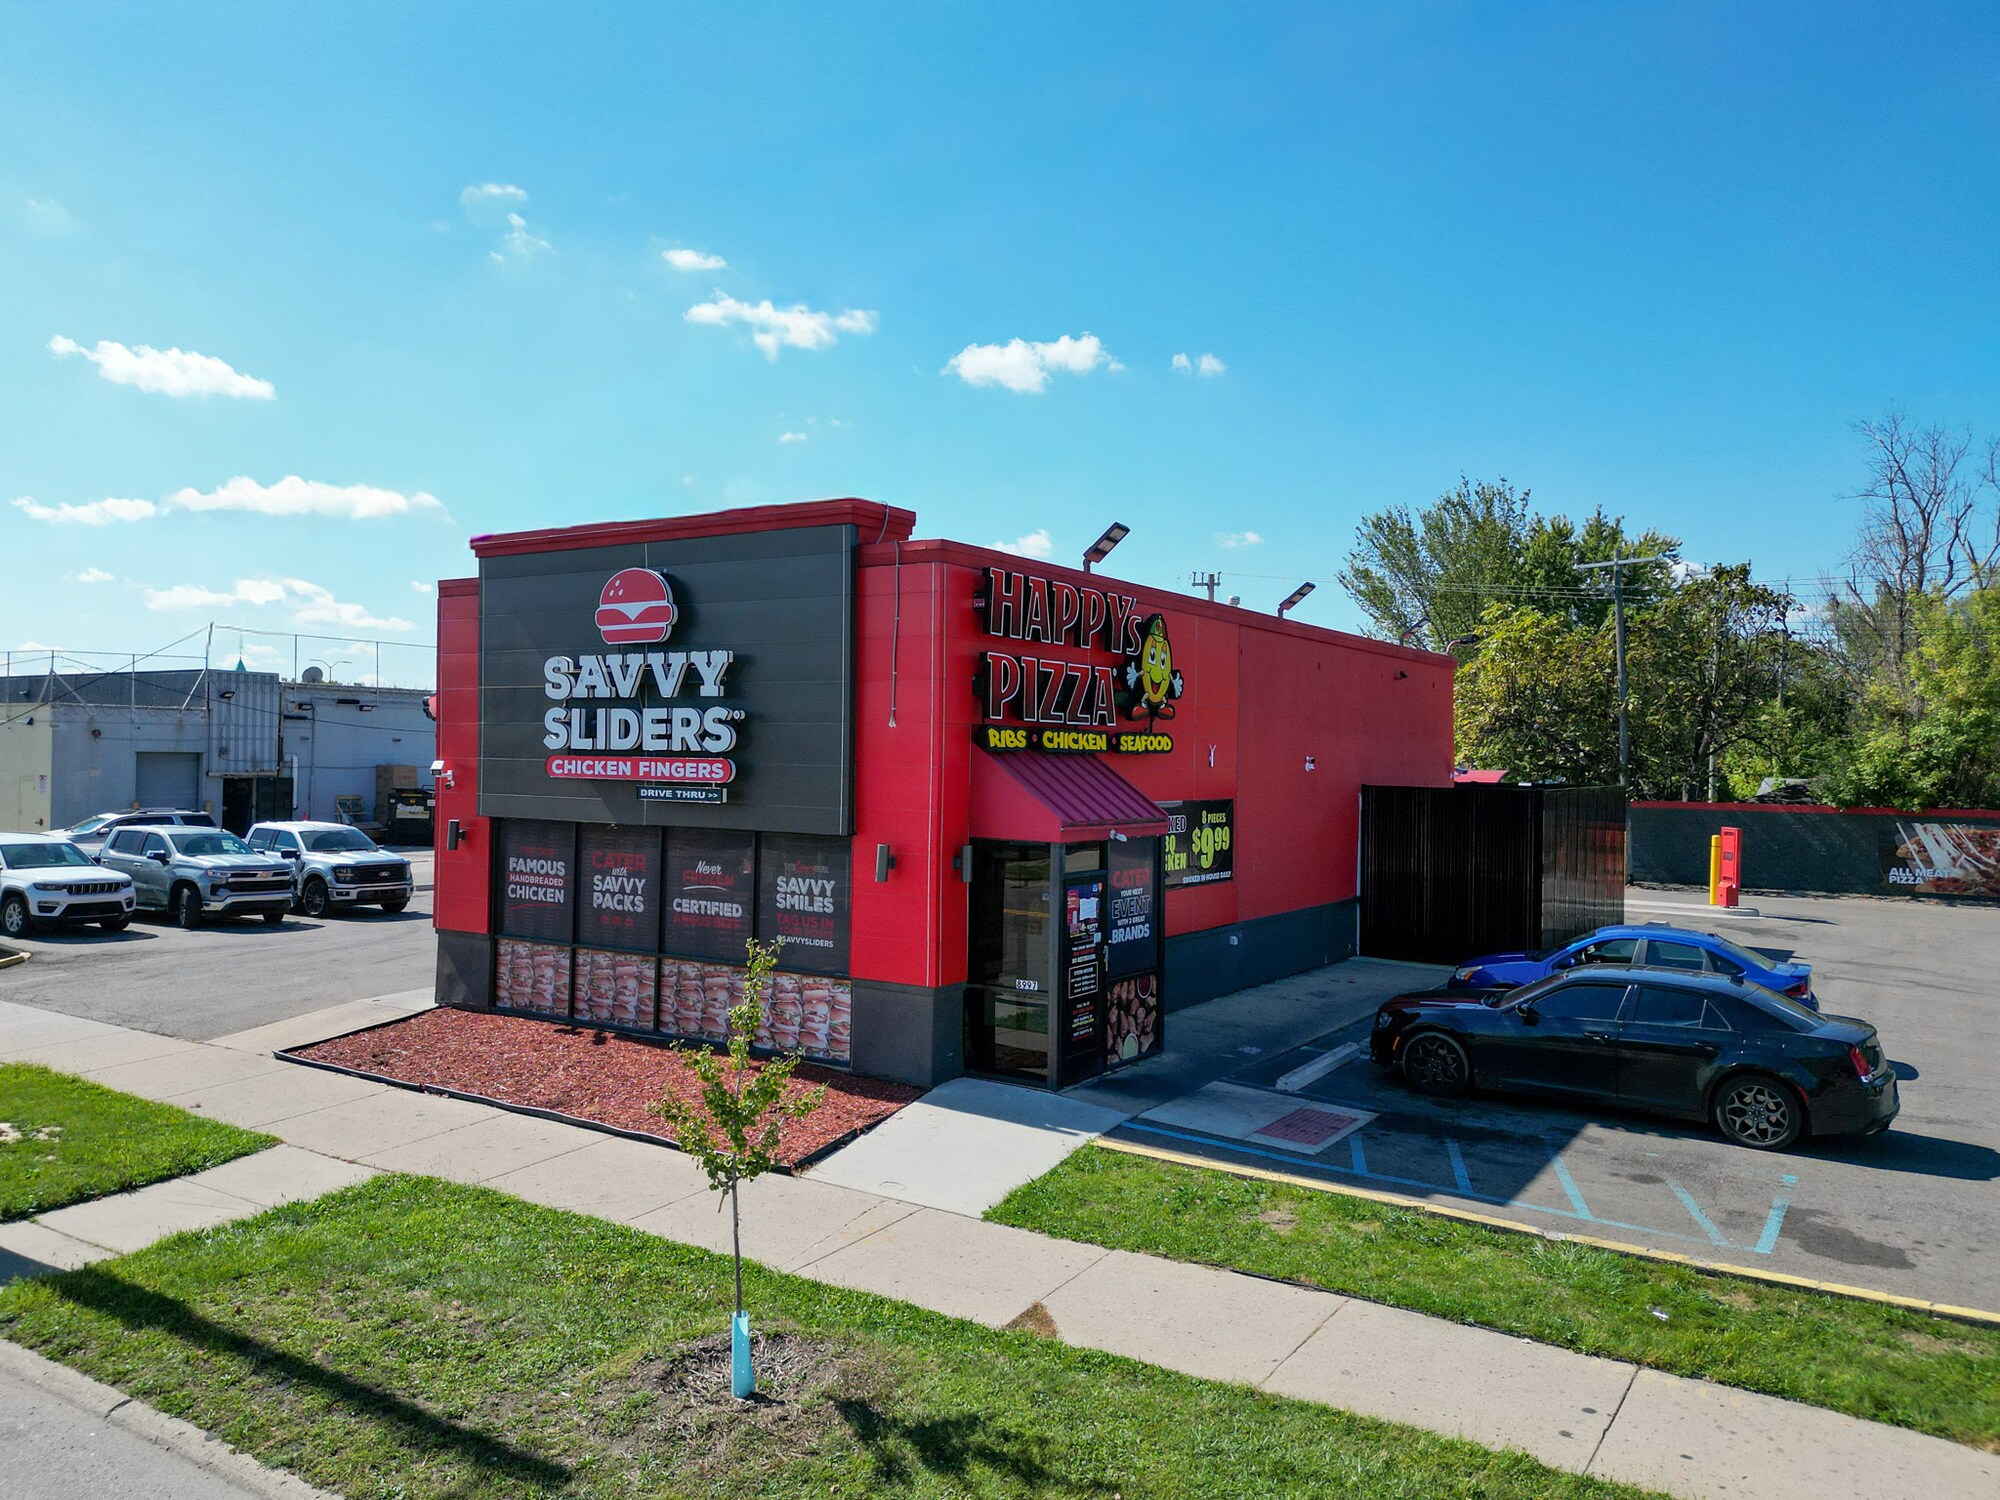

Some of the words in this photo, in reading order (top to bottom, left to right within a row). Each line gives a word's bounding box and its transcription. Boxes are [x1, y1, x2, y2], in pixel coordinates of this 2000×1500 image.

[544, 651, 733, 700] SAVVY
[987, 652, 1117, 726] PIZZA
[543, 706, 737, 753] SLIDERS
[988, 728, 1027, 748] RIBS
[1042, 730, 1107, 750] CHICKEN
[1120, 734, 1172, 751] SEAFOOD
[551, 759, 632, 777] CHICKEN
[639, 761, 724, 779] FINGERS
[640, 788, 673, 798] DRIVE
[675, 790, 706, 799] THRU
[1201, 810, 1207, 824] 8
[1207, 812, 1226, 824] PIECES
[509, 857, 566, 877] FAMOUS
[591, 850, 647, 872] CATER
[695, 860, 723, 875] Never
[510, 874, 564, 887] HANDBREADED
[1112, 868, 1150, 889] CATER
[1889, 867, 1913, 876] ALL
[1915, 868, 1950, 878] MEAT
[1889, 875, 1924, 884] PIZZA
[507, 884, 565, 904] CHICKEN
[593, 874, 646, 894] SAVVY
[776, 875, 835, 897] SAVVY
[592, 892, 645, 913] PACKS
[672, 898, 742, 918] CERTIFIED
[776, 893, 834, 914] SMILES
[1111, 895, 1150, 919] EVENT
[776, 912, 799, 926] TAG
[801, 915, 818, 929] US
[820, 917, 835, 929] IN
[1111, 923, 1150, 944] BRANDS
